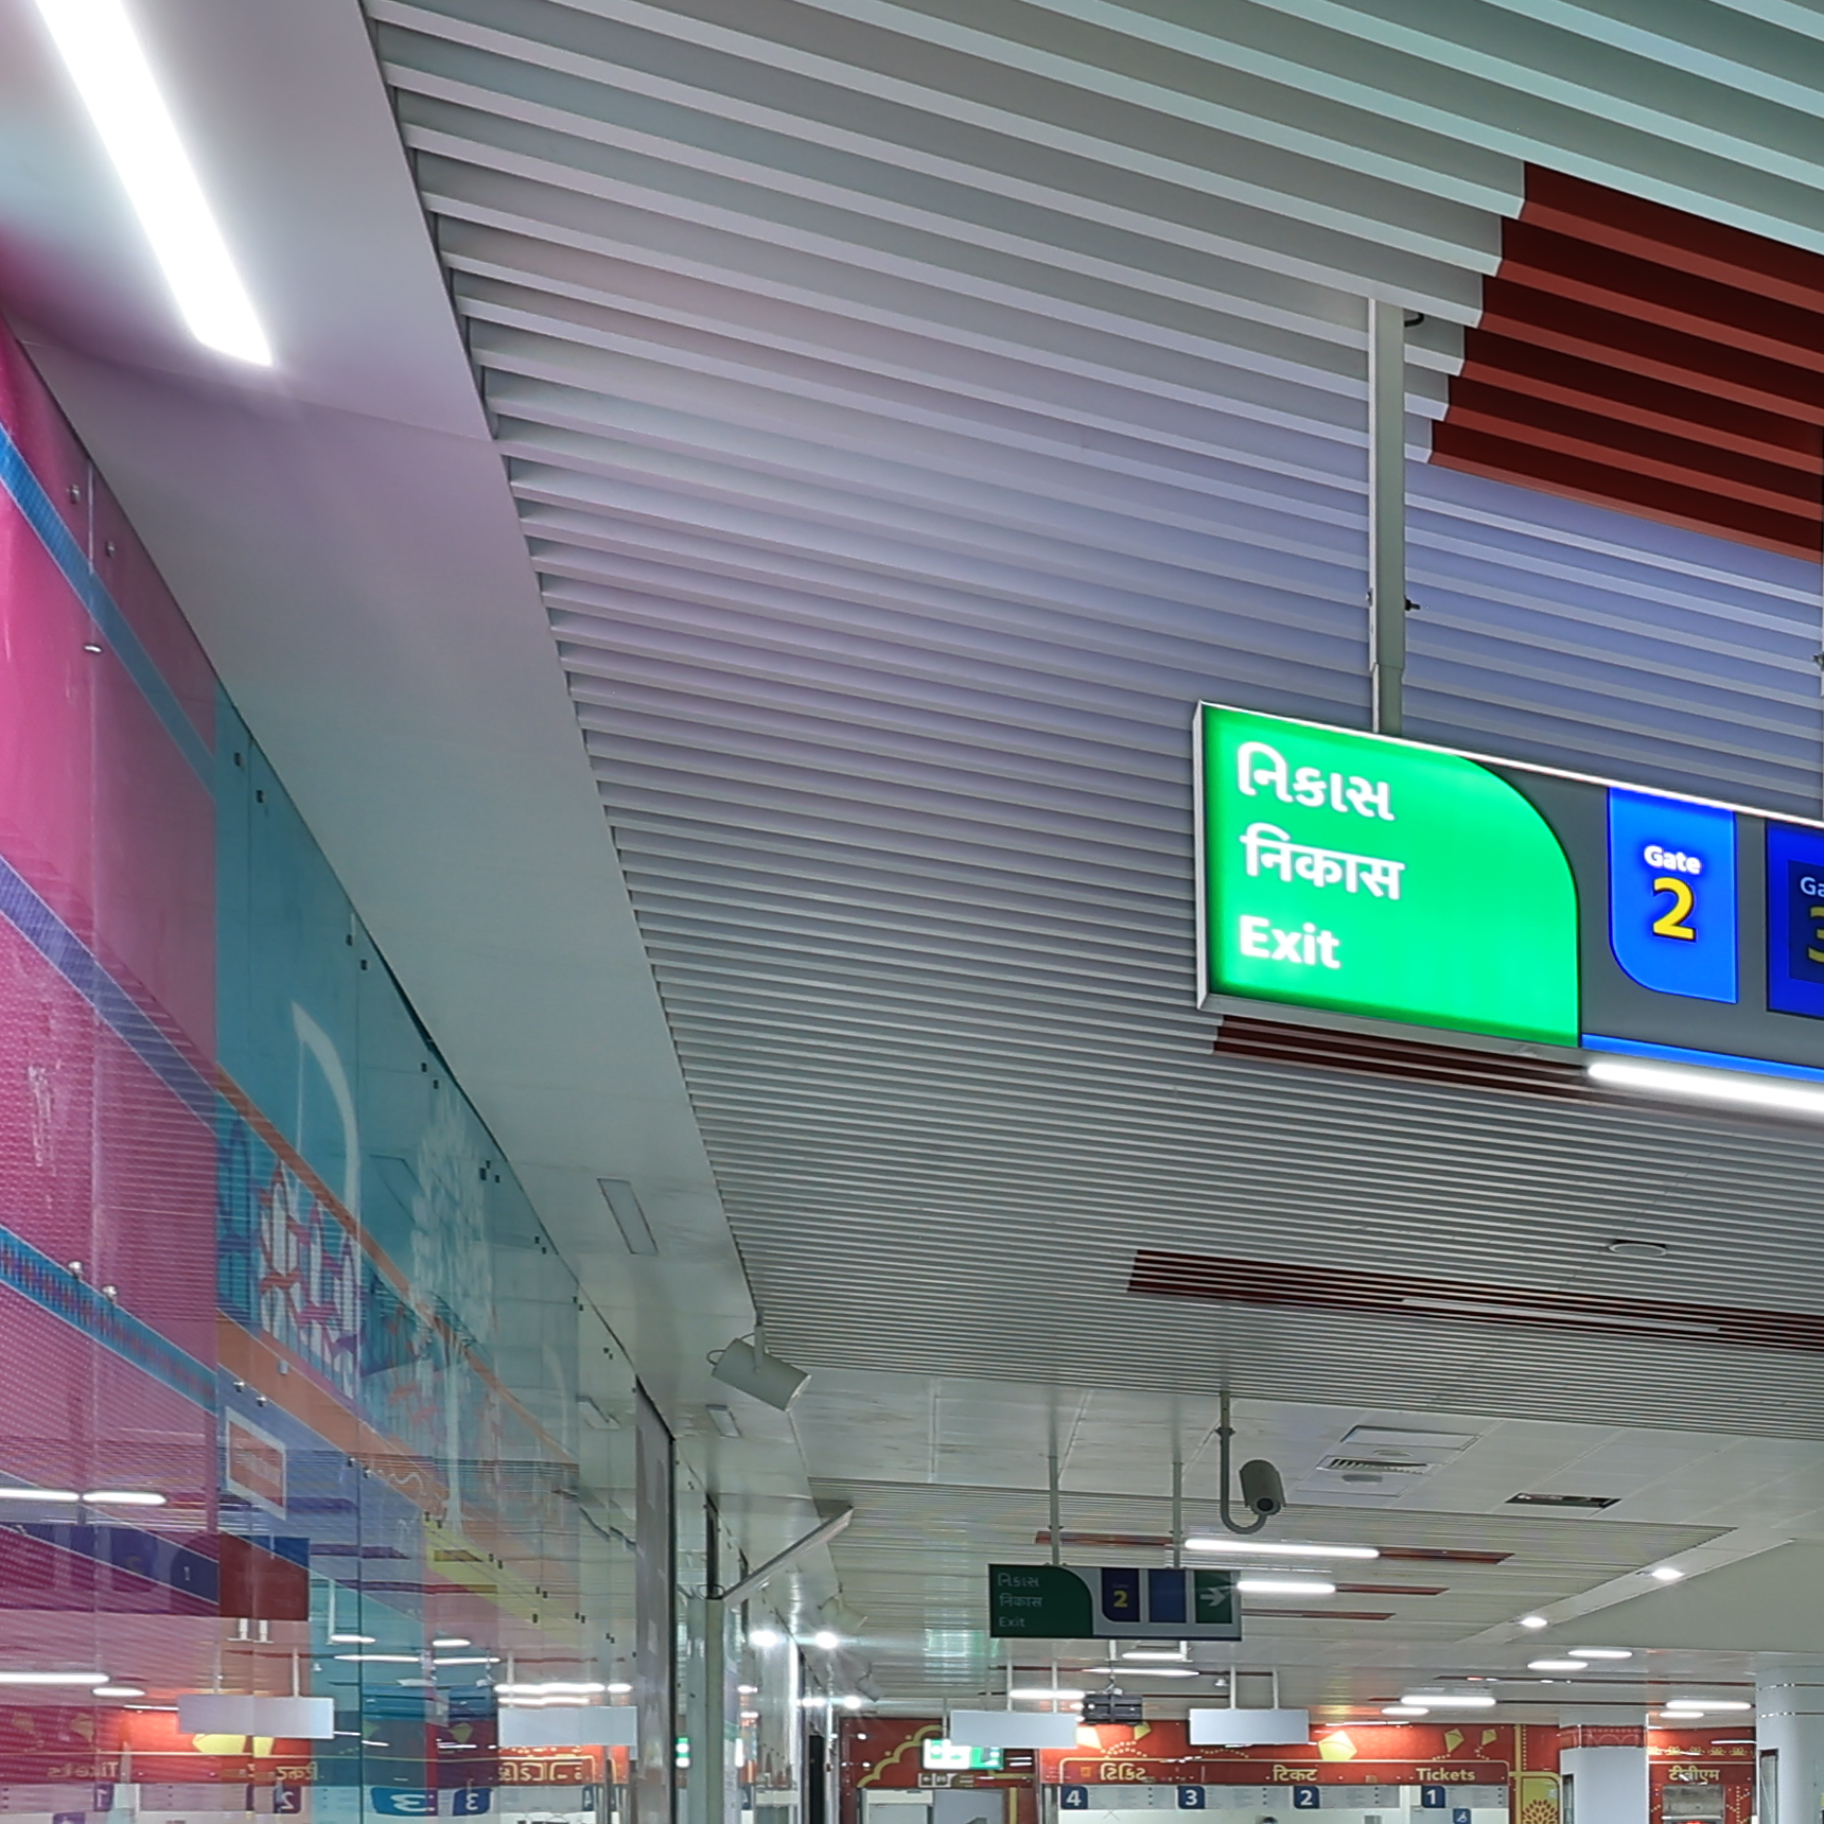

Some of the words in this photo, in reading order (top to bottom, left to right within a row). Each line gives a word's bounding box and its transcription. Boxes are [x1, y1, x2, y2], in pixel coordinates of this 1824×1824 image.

[1237, 741, 1396, 821] નિકાસ
[1238, 822, 1406, 900] निकास
[1643, 845, 1702, 875] Gate
[1652, 876, 1697, 942] 2
[1239, 914, 1342, 969] Exit
[999, 1592, 1043, 1607] निकास
[1113, 1589, 1128, 1608] 2
[998, 1616, 1026, 1628] Exit
[1100, 1762, 1146, 1781] ટિકિટ
[1272, 1764, 1318, 1781] टिकट
[1416, 1767, 1475, 1782] Tickets
[1066, 1790, 1082, 1807] 4
[1185, 1790, 1199, 1806] 3
[1300, 1790, 1313, 1806] 2
[1427, 1790, 1437, 1805] 1
